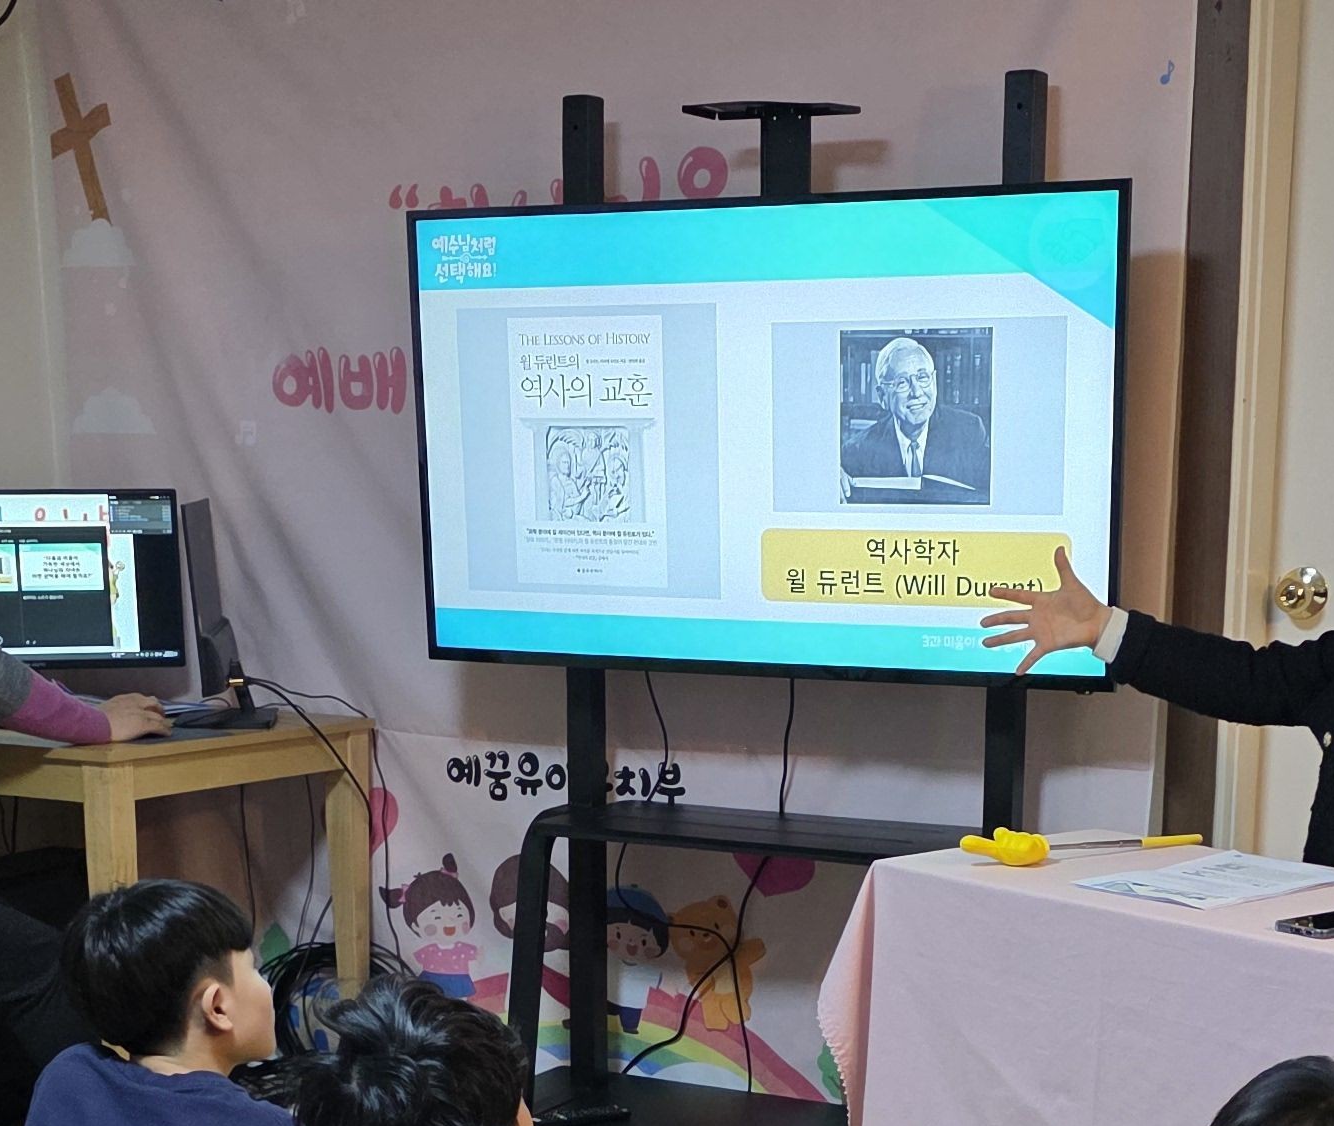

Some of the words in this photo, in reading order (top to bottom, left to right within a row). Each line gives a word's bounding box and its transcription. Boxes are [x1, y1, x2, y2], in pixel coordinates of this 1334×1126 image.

[431, 234, 497, 256] 예수님처럼
[434, 262, 497, 284] 선택해요!
[519, 333, 540, 345] THE
[543, 333, 585, 345] LESSONS
[588, 333, 602, 345] OF
[606, 332, 651, 345] HISTORY
[534, 354, 580, 370] 듀런트의
[521, 373, 592, 408] 역사의
[599, 373, 653, 407] 교훈
[866, 538, 960, 566] 역사학자
[786, 568, 806, 594] 윌
[816, 570, 885, 595] 듀런트
[895, 573, 946, 599] (Will
[446, 750, 686, 806] 예꿈유아치부
